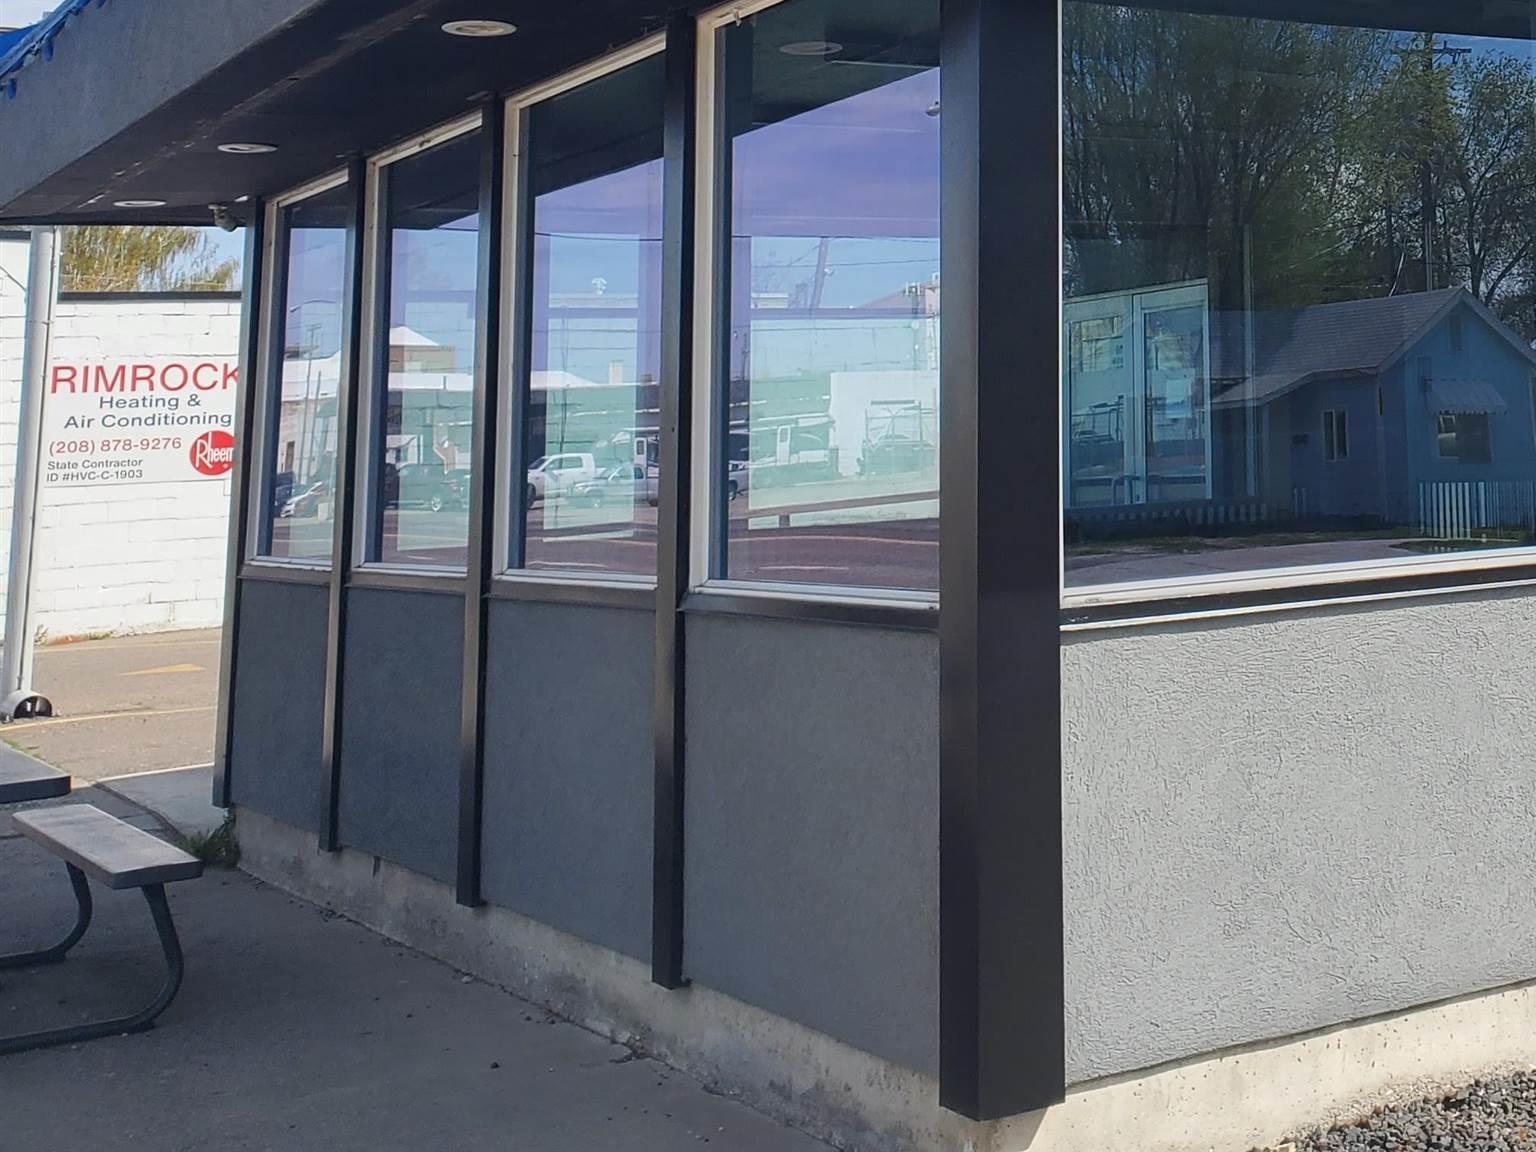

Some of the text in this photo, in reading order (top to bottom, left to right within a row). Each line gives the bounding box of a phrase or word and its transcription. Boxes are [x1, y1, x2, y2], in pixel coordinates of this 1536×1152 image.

[51, 363, 239, 393] RIMROCK
[99, 394, 201, 410] Heating &
[64, 412, 232, 429] Air Conditioning
[49, 437, 182, 457] (208) 878-9276
[47, 458, 144, 470] State Contractor
[46, 473, 59, 482] ID
